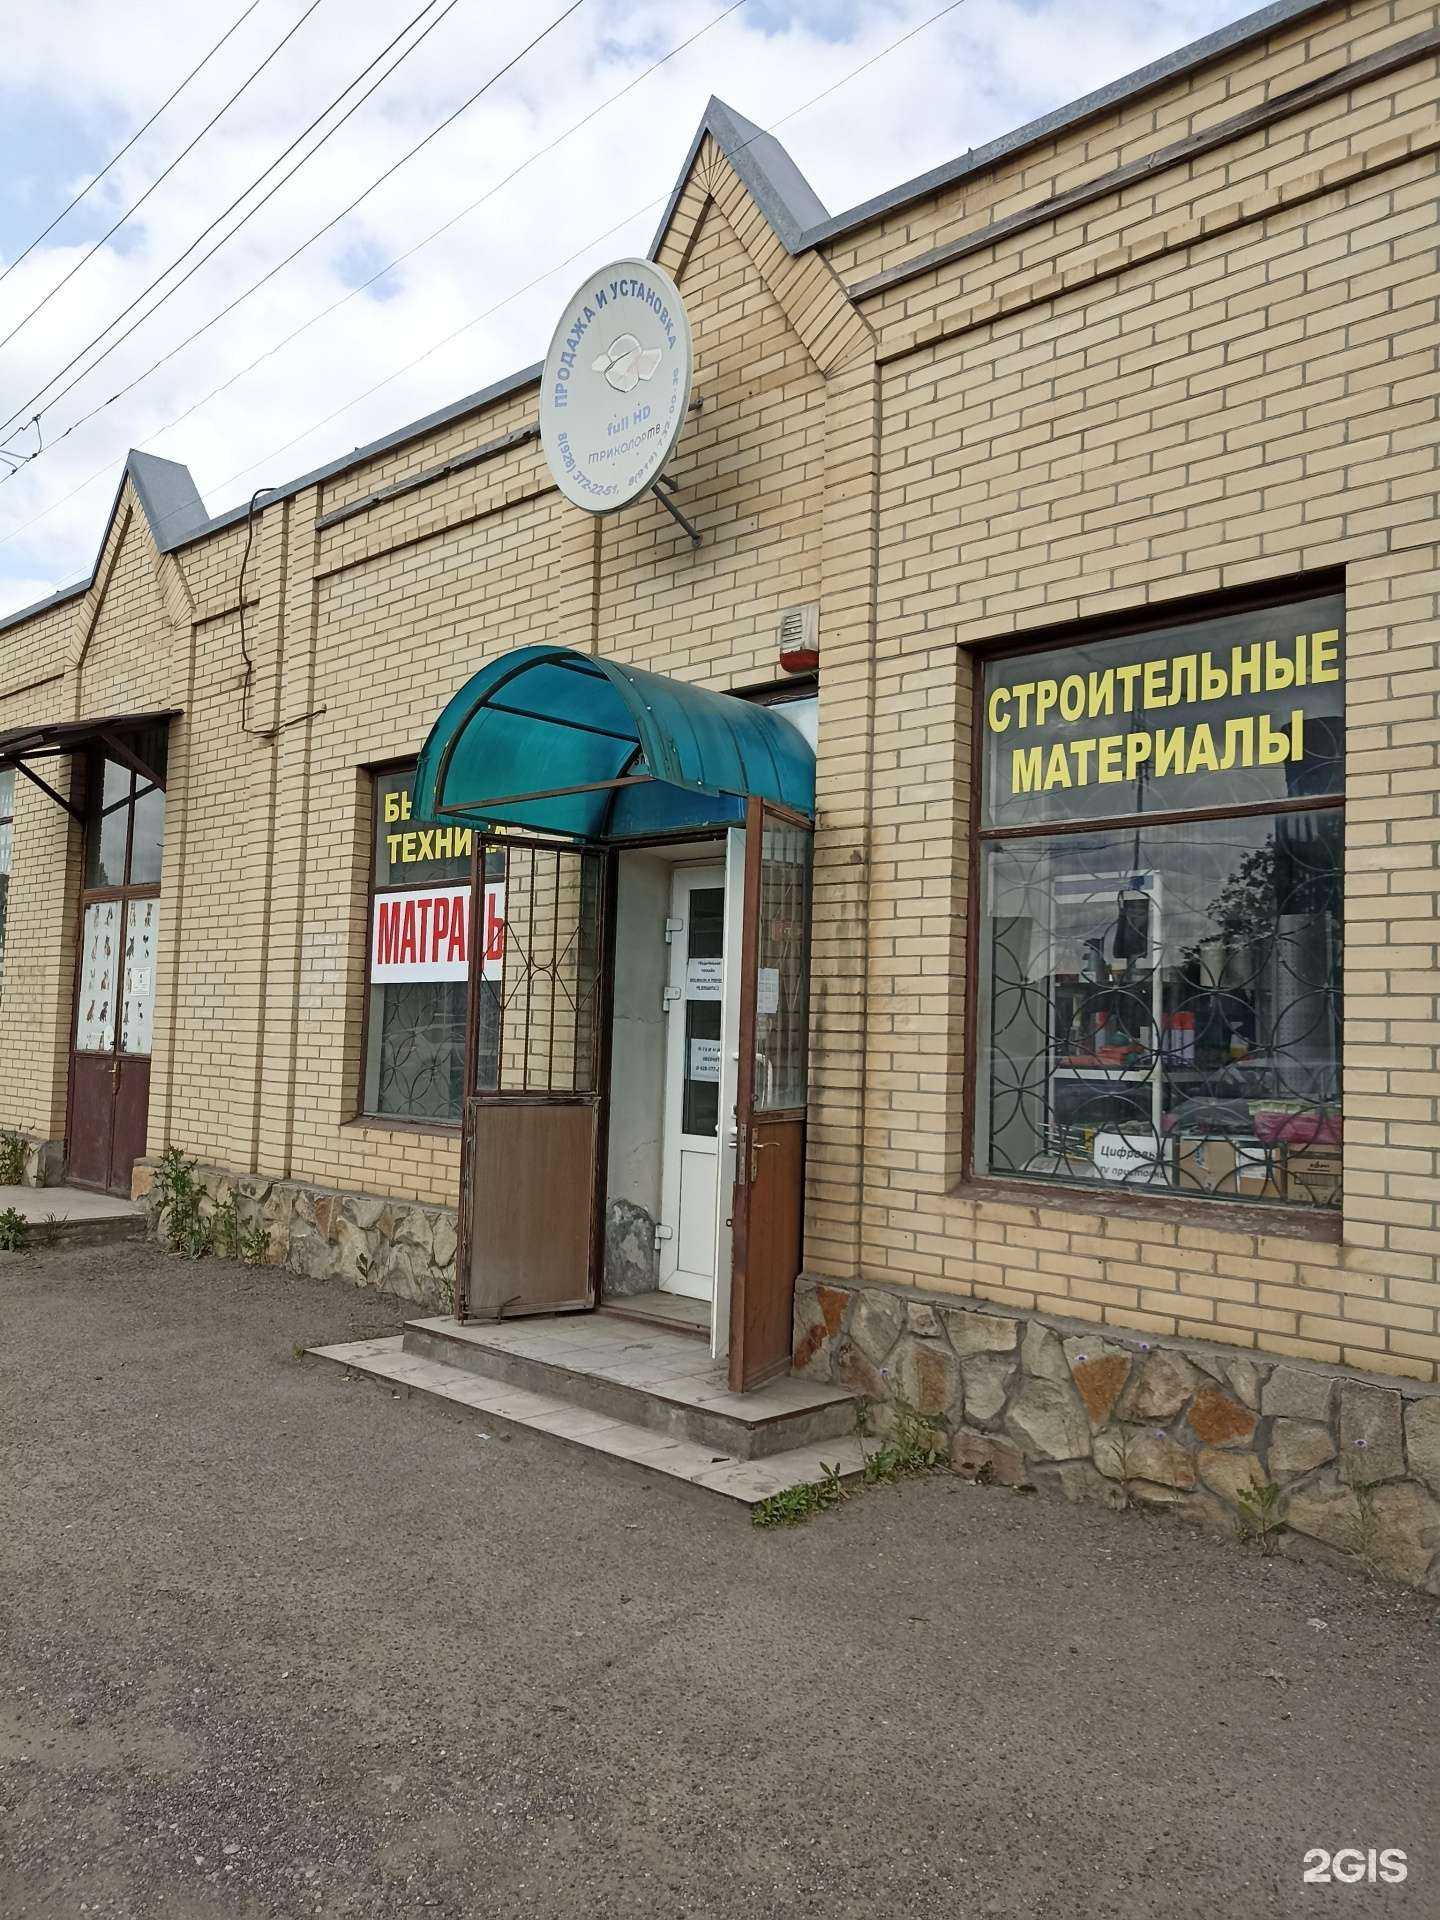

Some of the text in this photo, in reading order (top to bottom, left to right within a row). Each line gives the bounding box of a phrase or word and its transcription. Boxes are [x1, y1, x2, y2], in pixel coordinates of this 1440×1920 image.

[554, 306, 596, 408] ПРОДАЖА
[596, 289, 608, 309] И
[609, 279, 677, 350] УСТАНОВКА
[558, 432, 576, 473] 8(928)
[633, 406, 651, 424] HD
[988, 629, 1340, 733] СТРОИТЕЛЬНЫЕ
[1012, 710, 1304, 794] МАТЕРИАЛЫ
